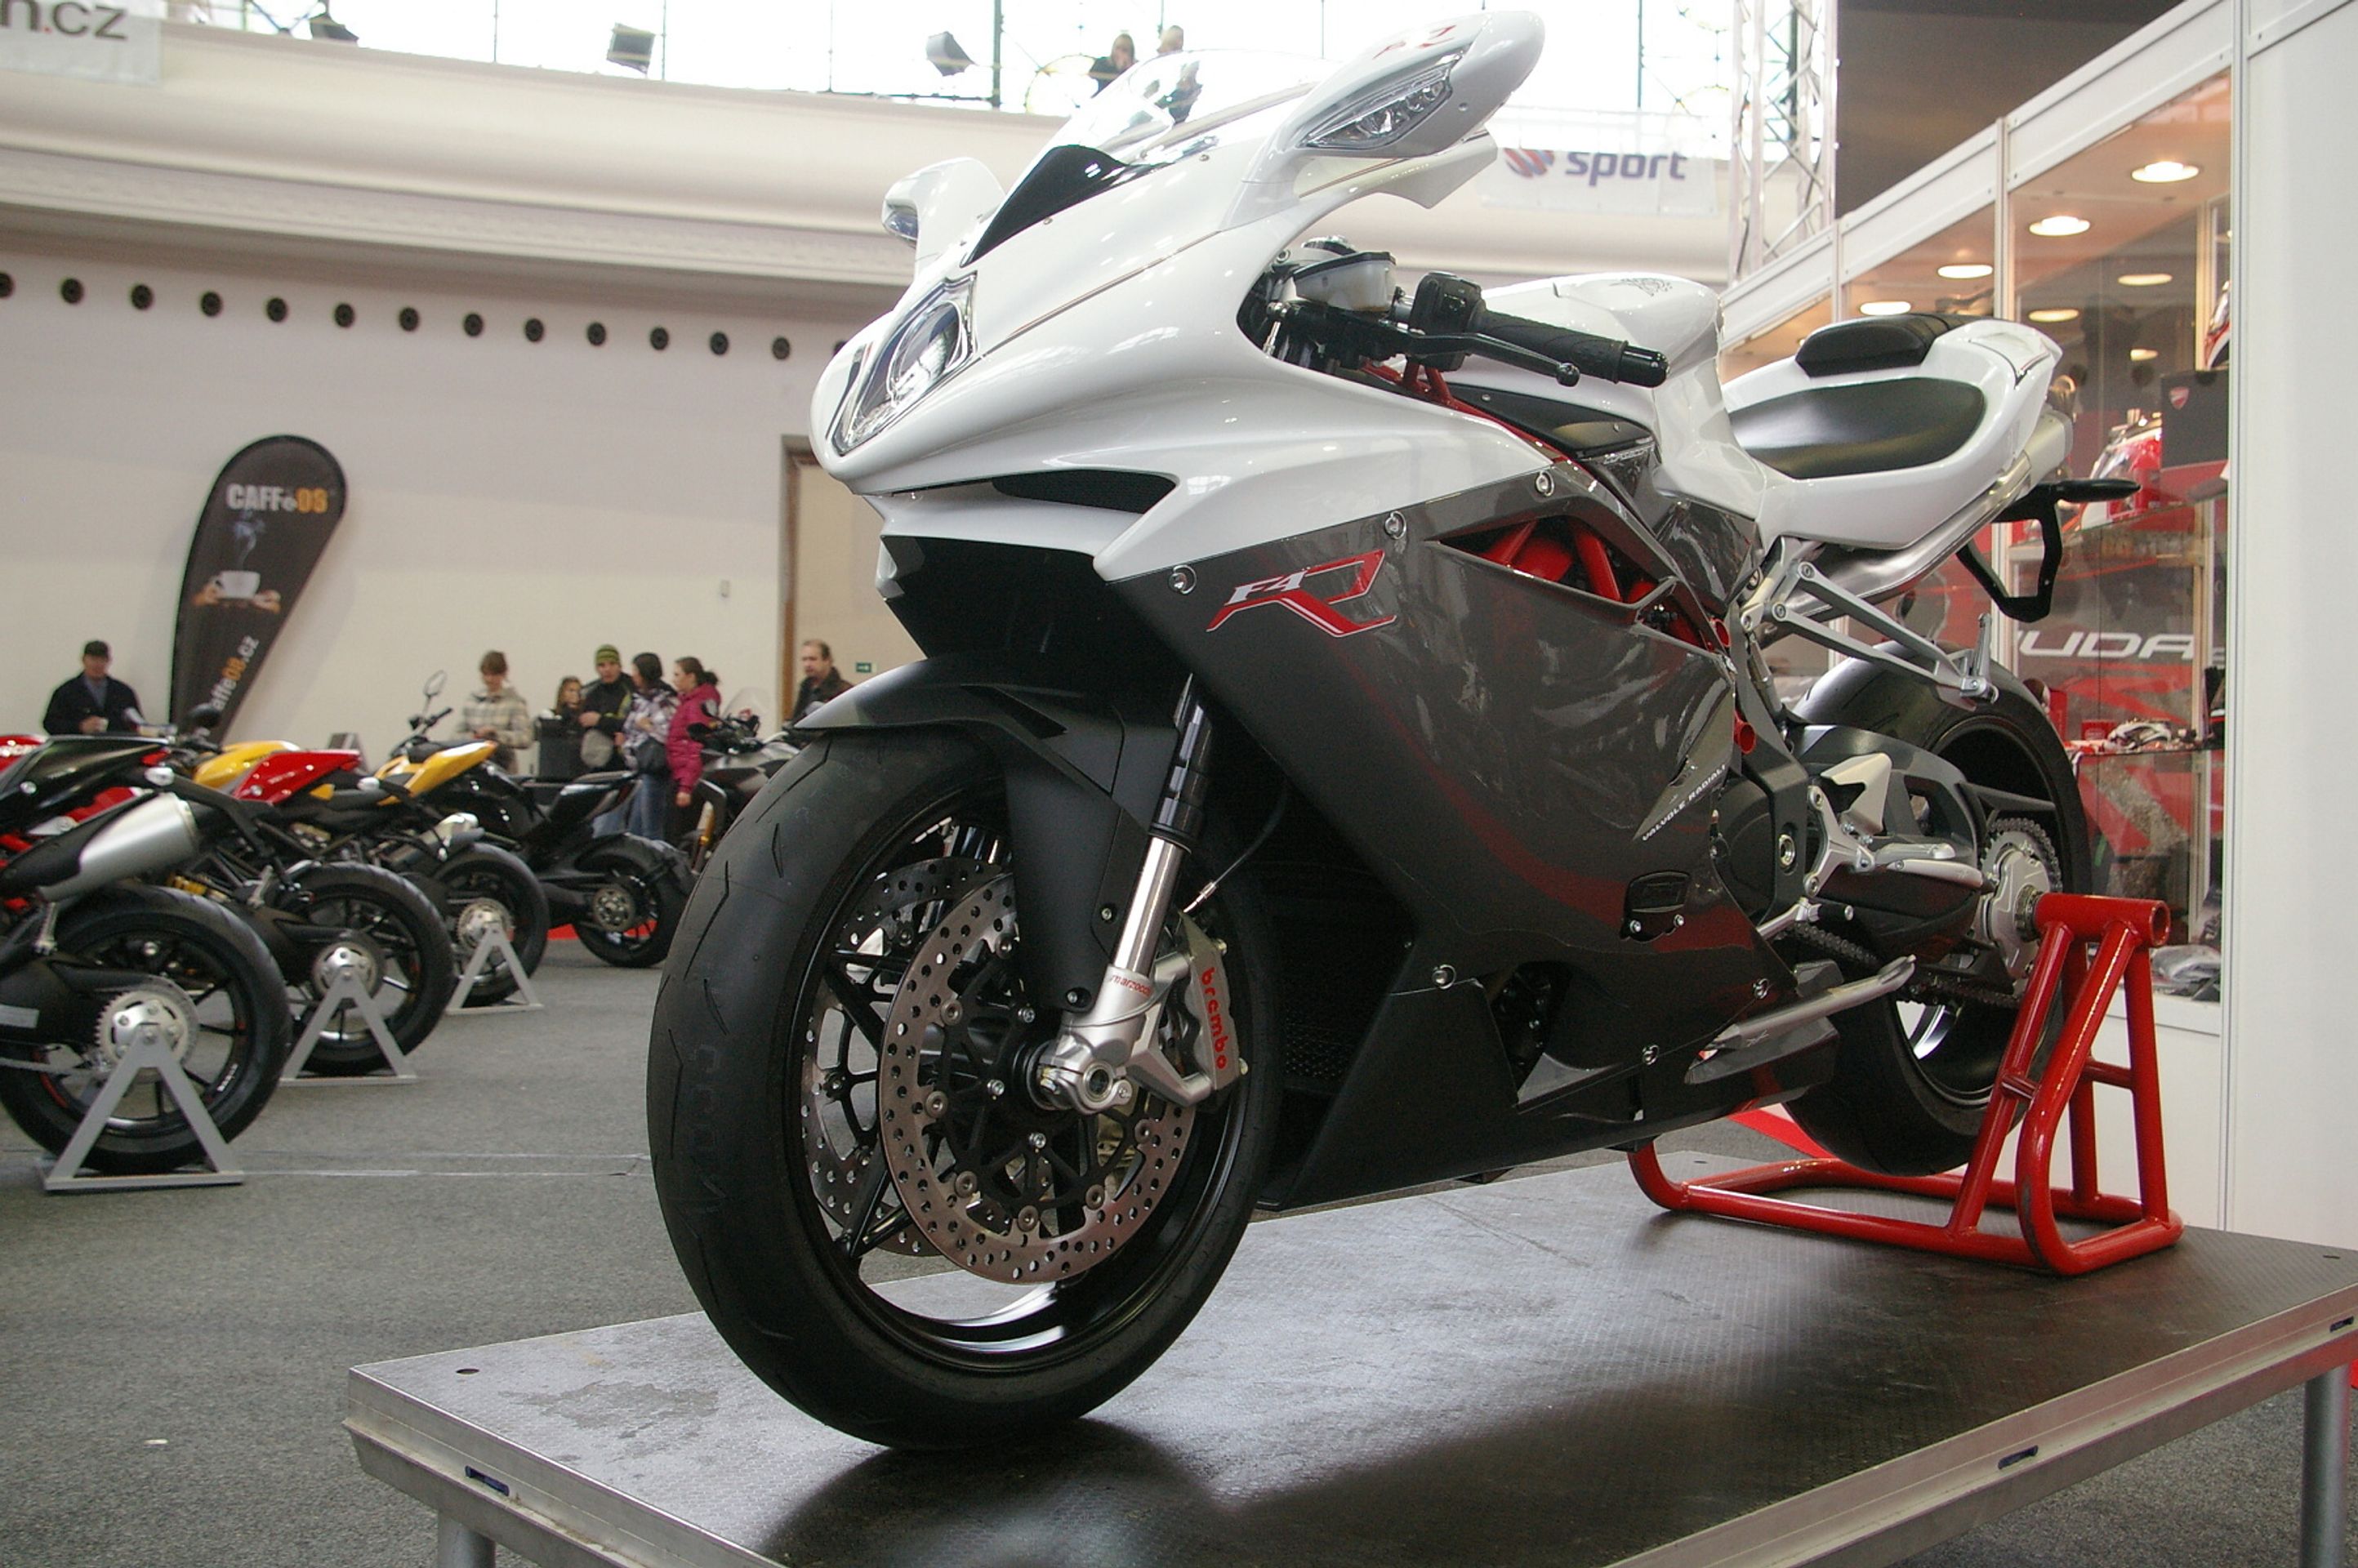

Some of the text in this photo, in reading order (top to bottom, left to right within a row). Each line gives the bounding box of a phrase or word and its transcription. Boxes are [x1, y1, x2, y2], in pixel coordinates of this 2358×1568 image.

[1565, 151, 1687, 187] sport
[1224, 570, 1308, 606] F4
[2011, 630, 2195, 660] UDA
[1688, 764, 1726, 801] RADIALI
[1201, 966, 1229, 1070] brembo
